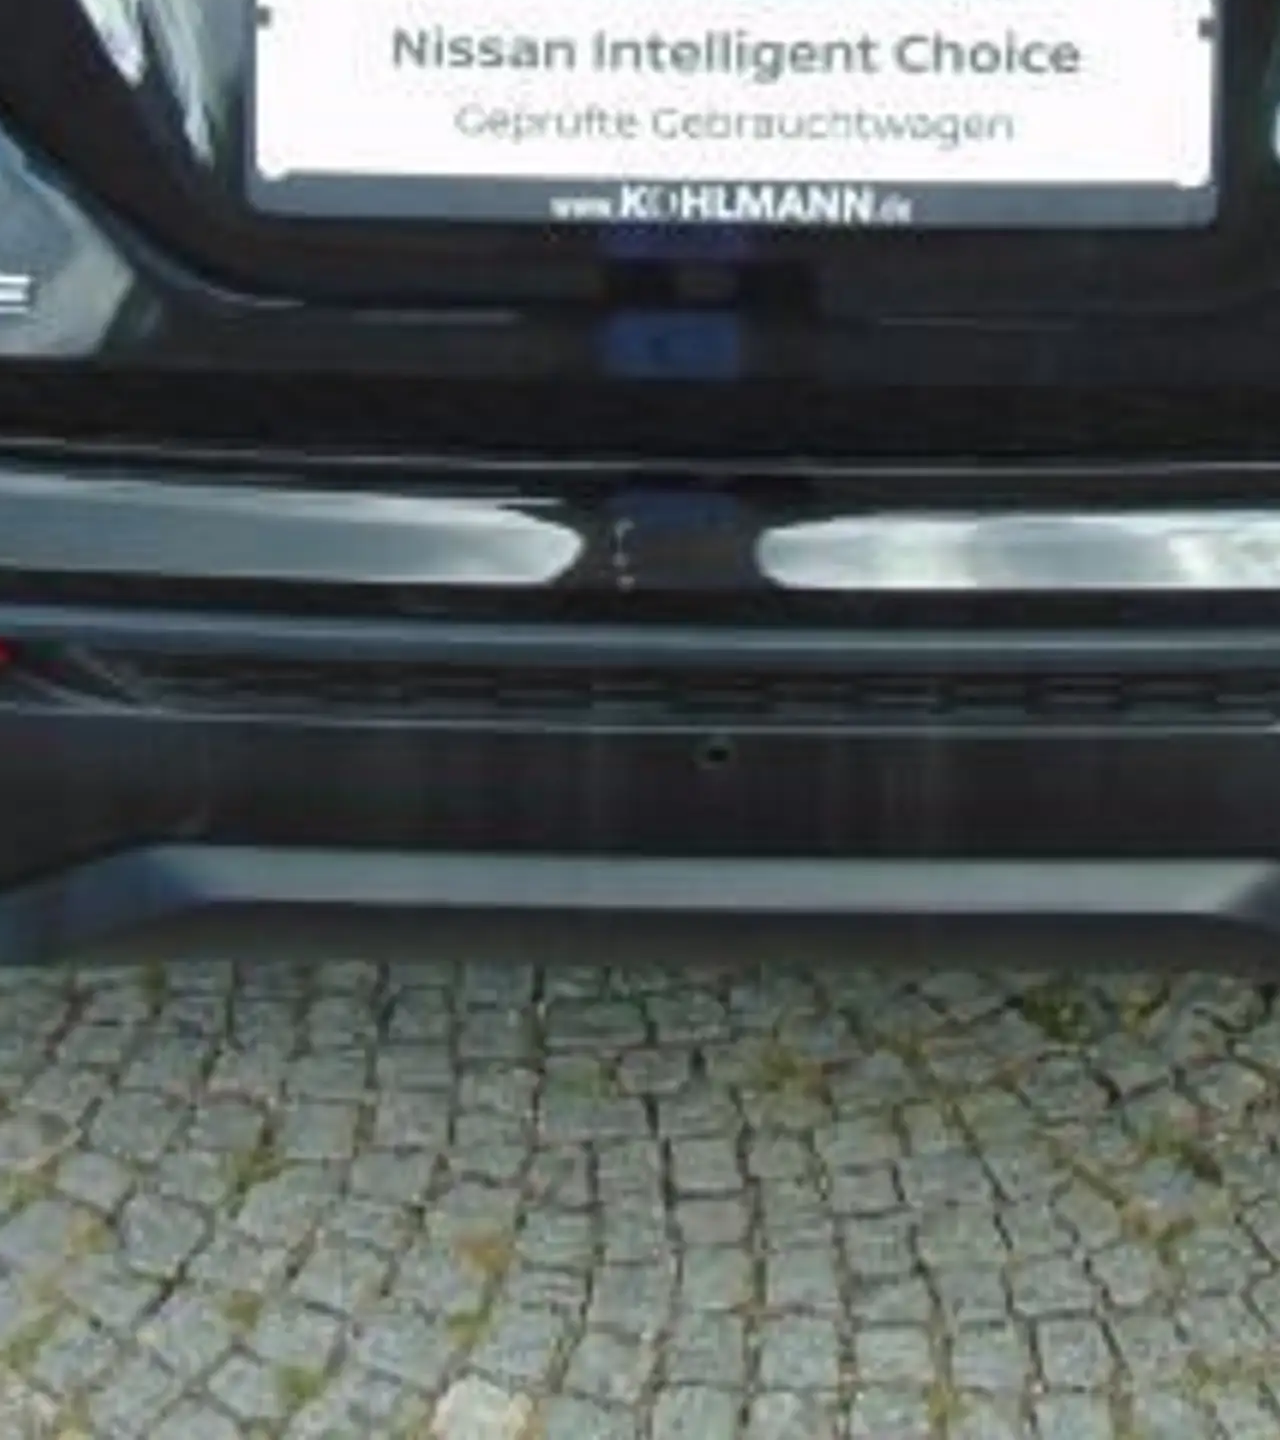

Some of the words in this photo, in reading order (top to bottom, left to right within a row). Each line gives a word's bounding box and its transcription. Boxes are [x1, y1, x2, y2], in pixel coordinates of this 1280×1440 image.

[391, 23, 577, 71] Nissan
[591, 27, 881, 86] Intelligent
[892, 29, 1082, 77] Choice
